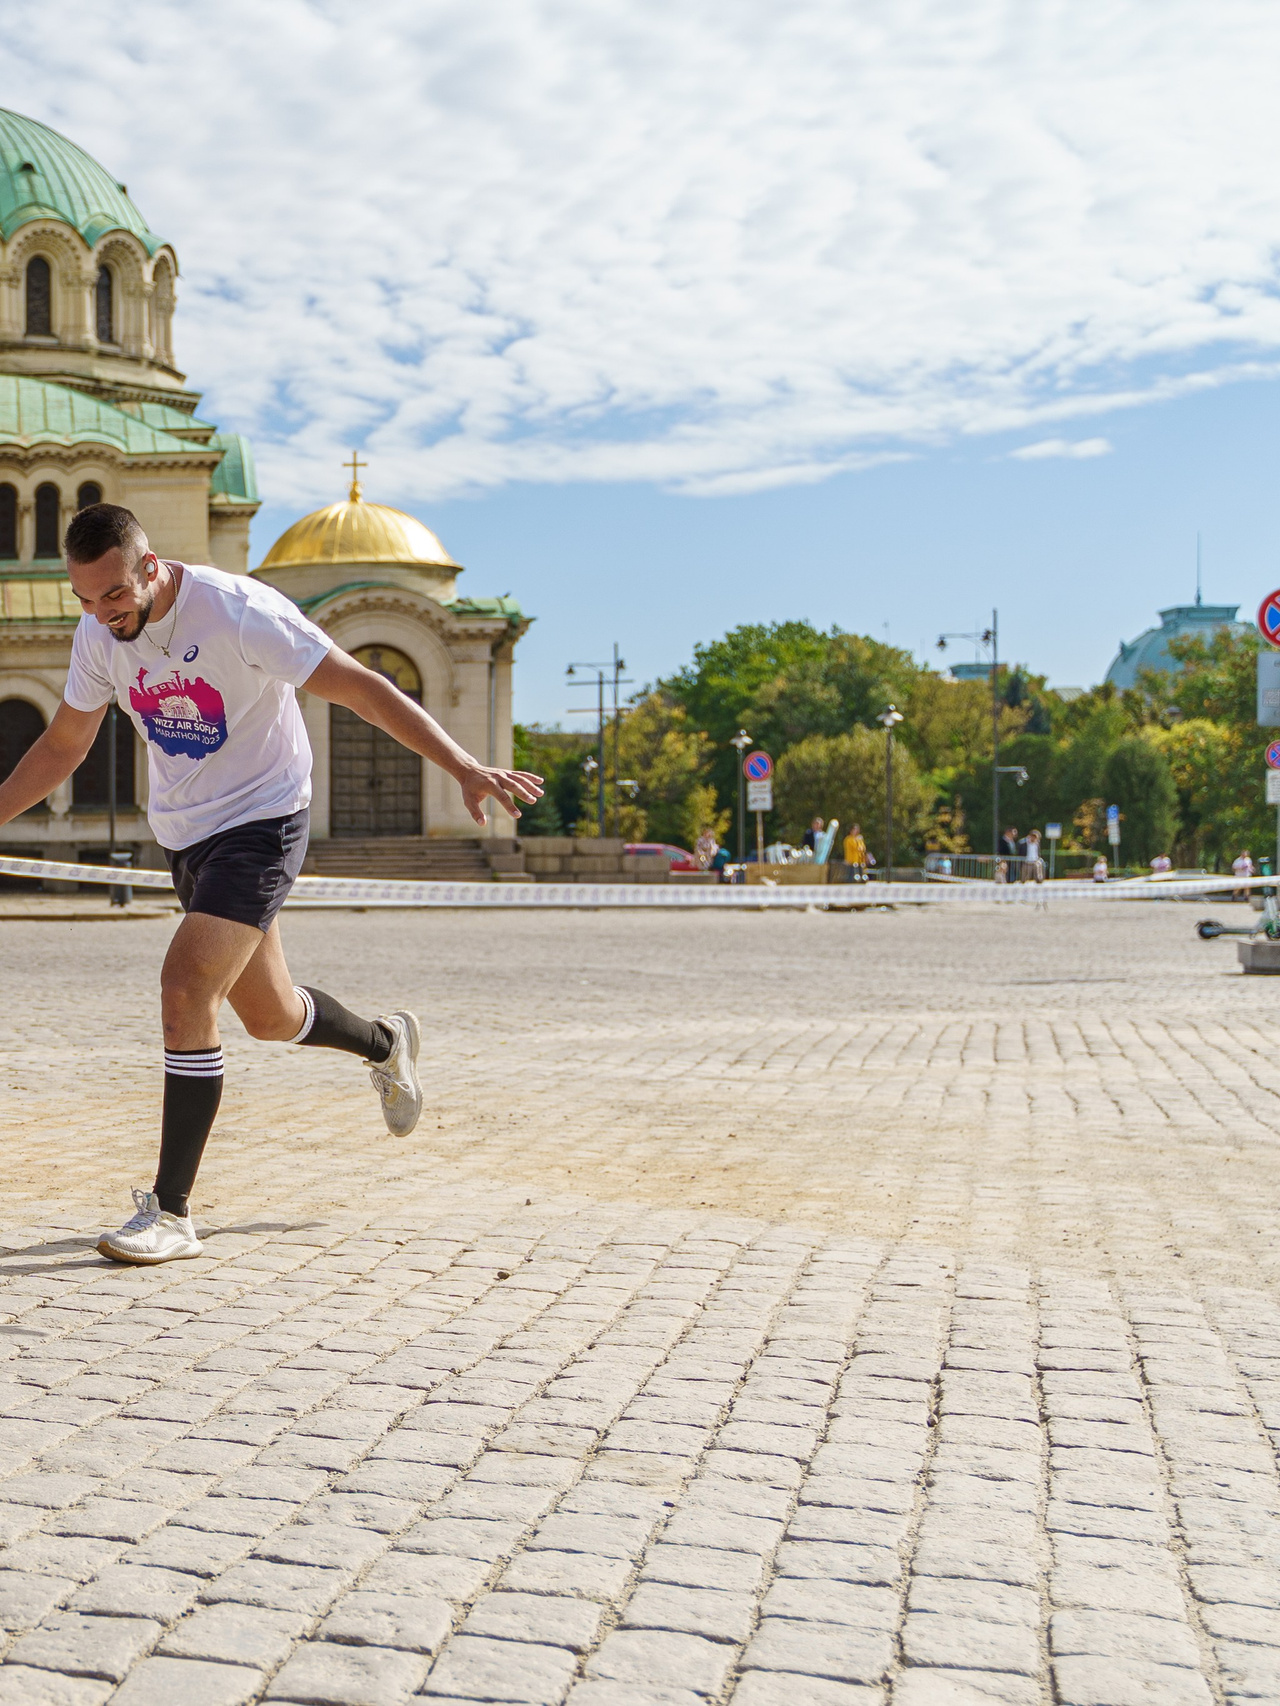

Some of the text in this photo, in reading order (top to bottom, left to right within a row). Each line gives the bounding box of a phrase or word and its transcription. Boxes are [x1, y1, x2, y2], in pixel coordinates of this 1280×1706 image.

[152, 717, 218, 734] WIZZ AIR SOFIA
[155, 727, 200, 741] MARATHON
